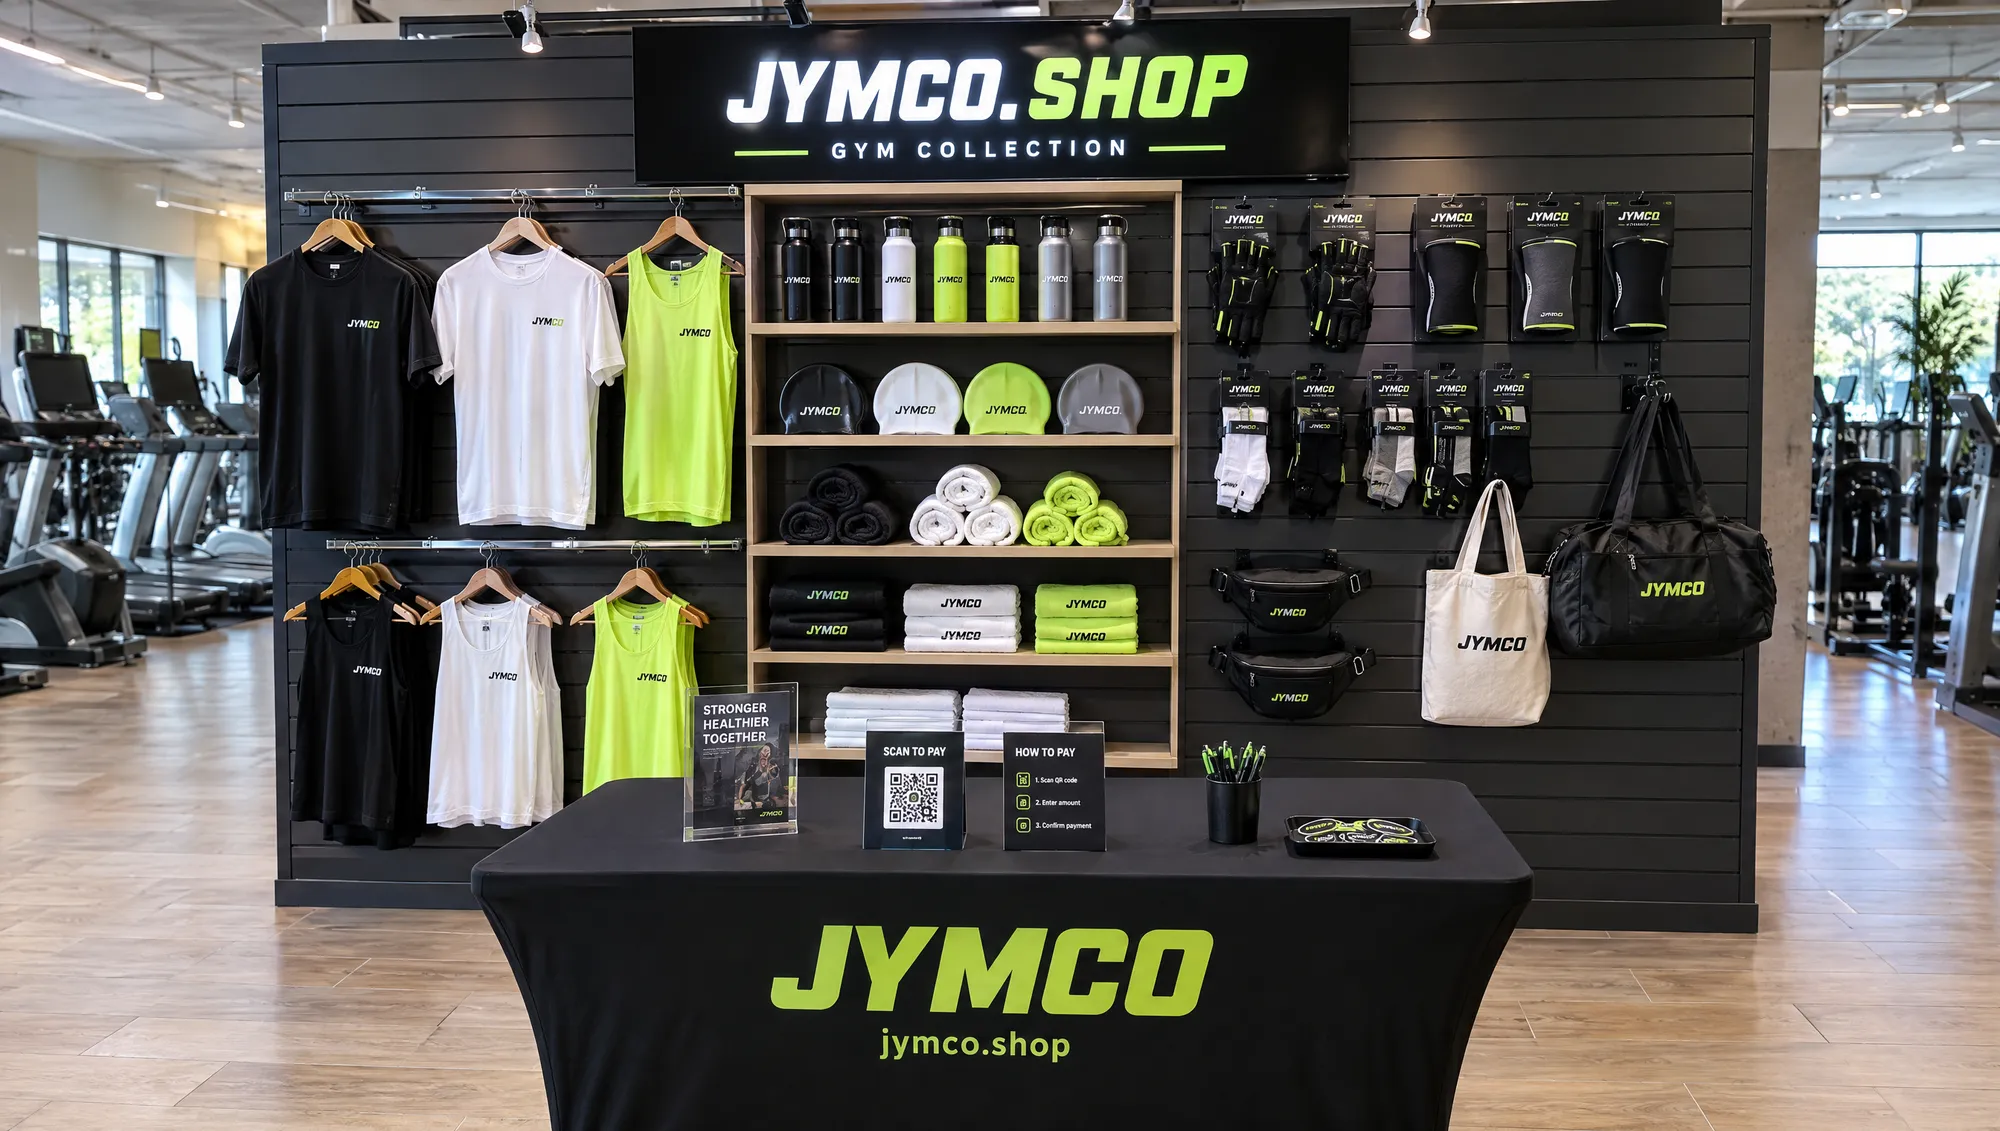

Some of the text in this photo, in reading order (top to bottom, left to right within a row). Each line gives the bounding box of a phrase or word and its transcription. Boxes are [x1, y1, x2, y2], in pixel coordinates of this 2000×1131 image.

[726, 53, 1249, 125] JYMCO.SHOP
[831, 139, 1127, 160] GYM COLLECTION
[784, 276, 811, 284] JYMCO
[834, 276, 861, 284] JYMCO
[1042, 275, 1069, 283] JYMCO
[1096, 275, 1124, 283] JYMCO
[347, 319, 380, 329] JYMCO
[531, 317, 564, 327] JYMCO
[679, 328, 711, 338] JYMCO
[1229, 385, 1261, 393] JYMCO
[1303, 385, 1335, 393] JYMCO
[1378, 384, 1410, 393] JYMCO
[1436, 384, 1467, 393] JYMCO
[1493, 384, 1525, 393] JYMCO
[1641, 580, 1706, 598] JYMCO
[807, 590, 849, 600] JYMCO
[940, 598, 982, 608] JYMCO
[1065, 599, 1107, 609] JYMCO
[1270, 607, 1307, 618] JYMCO
[806, 625, 848, 635] JYMCO
[940, 630, 981, 641] JYMCO
[1065, 632, 1106, 642] JYMCO
[1457, 635, 1528, 652] JYMCO
[352, 666, 382, 676] JYMCO
[488, 671, 518, 682] JYMCO
[636, 672, 668, 683] JYMCO
[1271, 693, 1309, 704] JYMCO
[703, 702, 767, 716] STRONGER
[703, 716, 770, 730] HEALTHIER
[702, 731, 767, 745] TOGETHER
[883, 746, 947, 757] SCAN TO PAY
[1015, 747, 1076, 757] HOW TO PAY
[1040, 776, 1054, 784] Scan
[1055, 776, 1064, 784] QR
[1064, 776, 1078, 784] code
[1042, 821, 1065, 829] Confirm
[1066, 823, 1092, 831] payment
[771, 924, 1214, 1017] JYMCO
[880, 1027, 1071, 1063] jymco.shop
